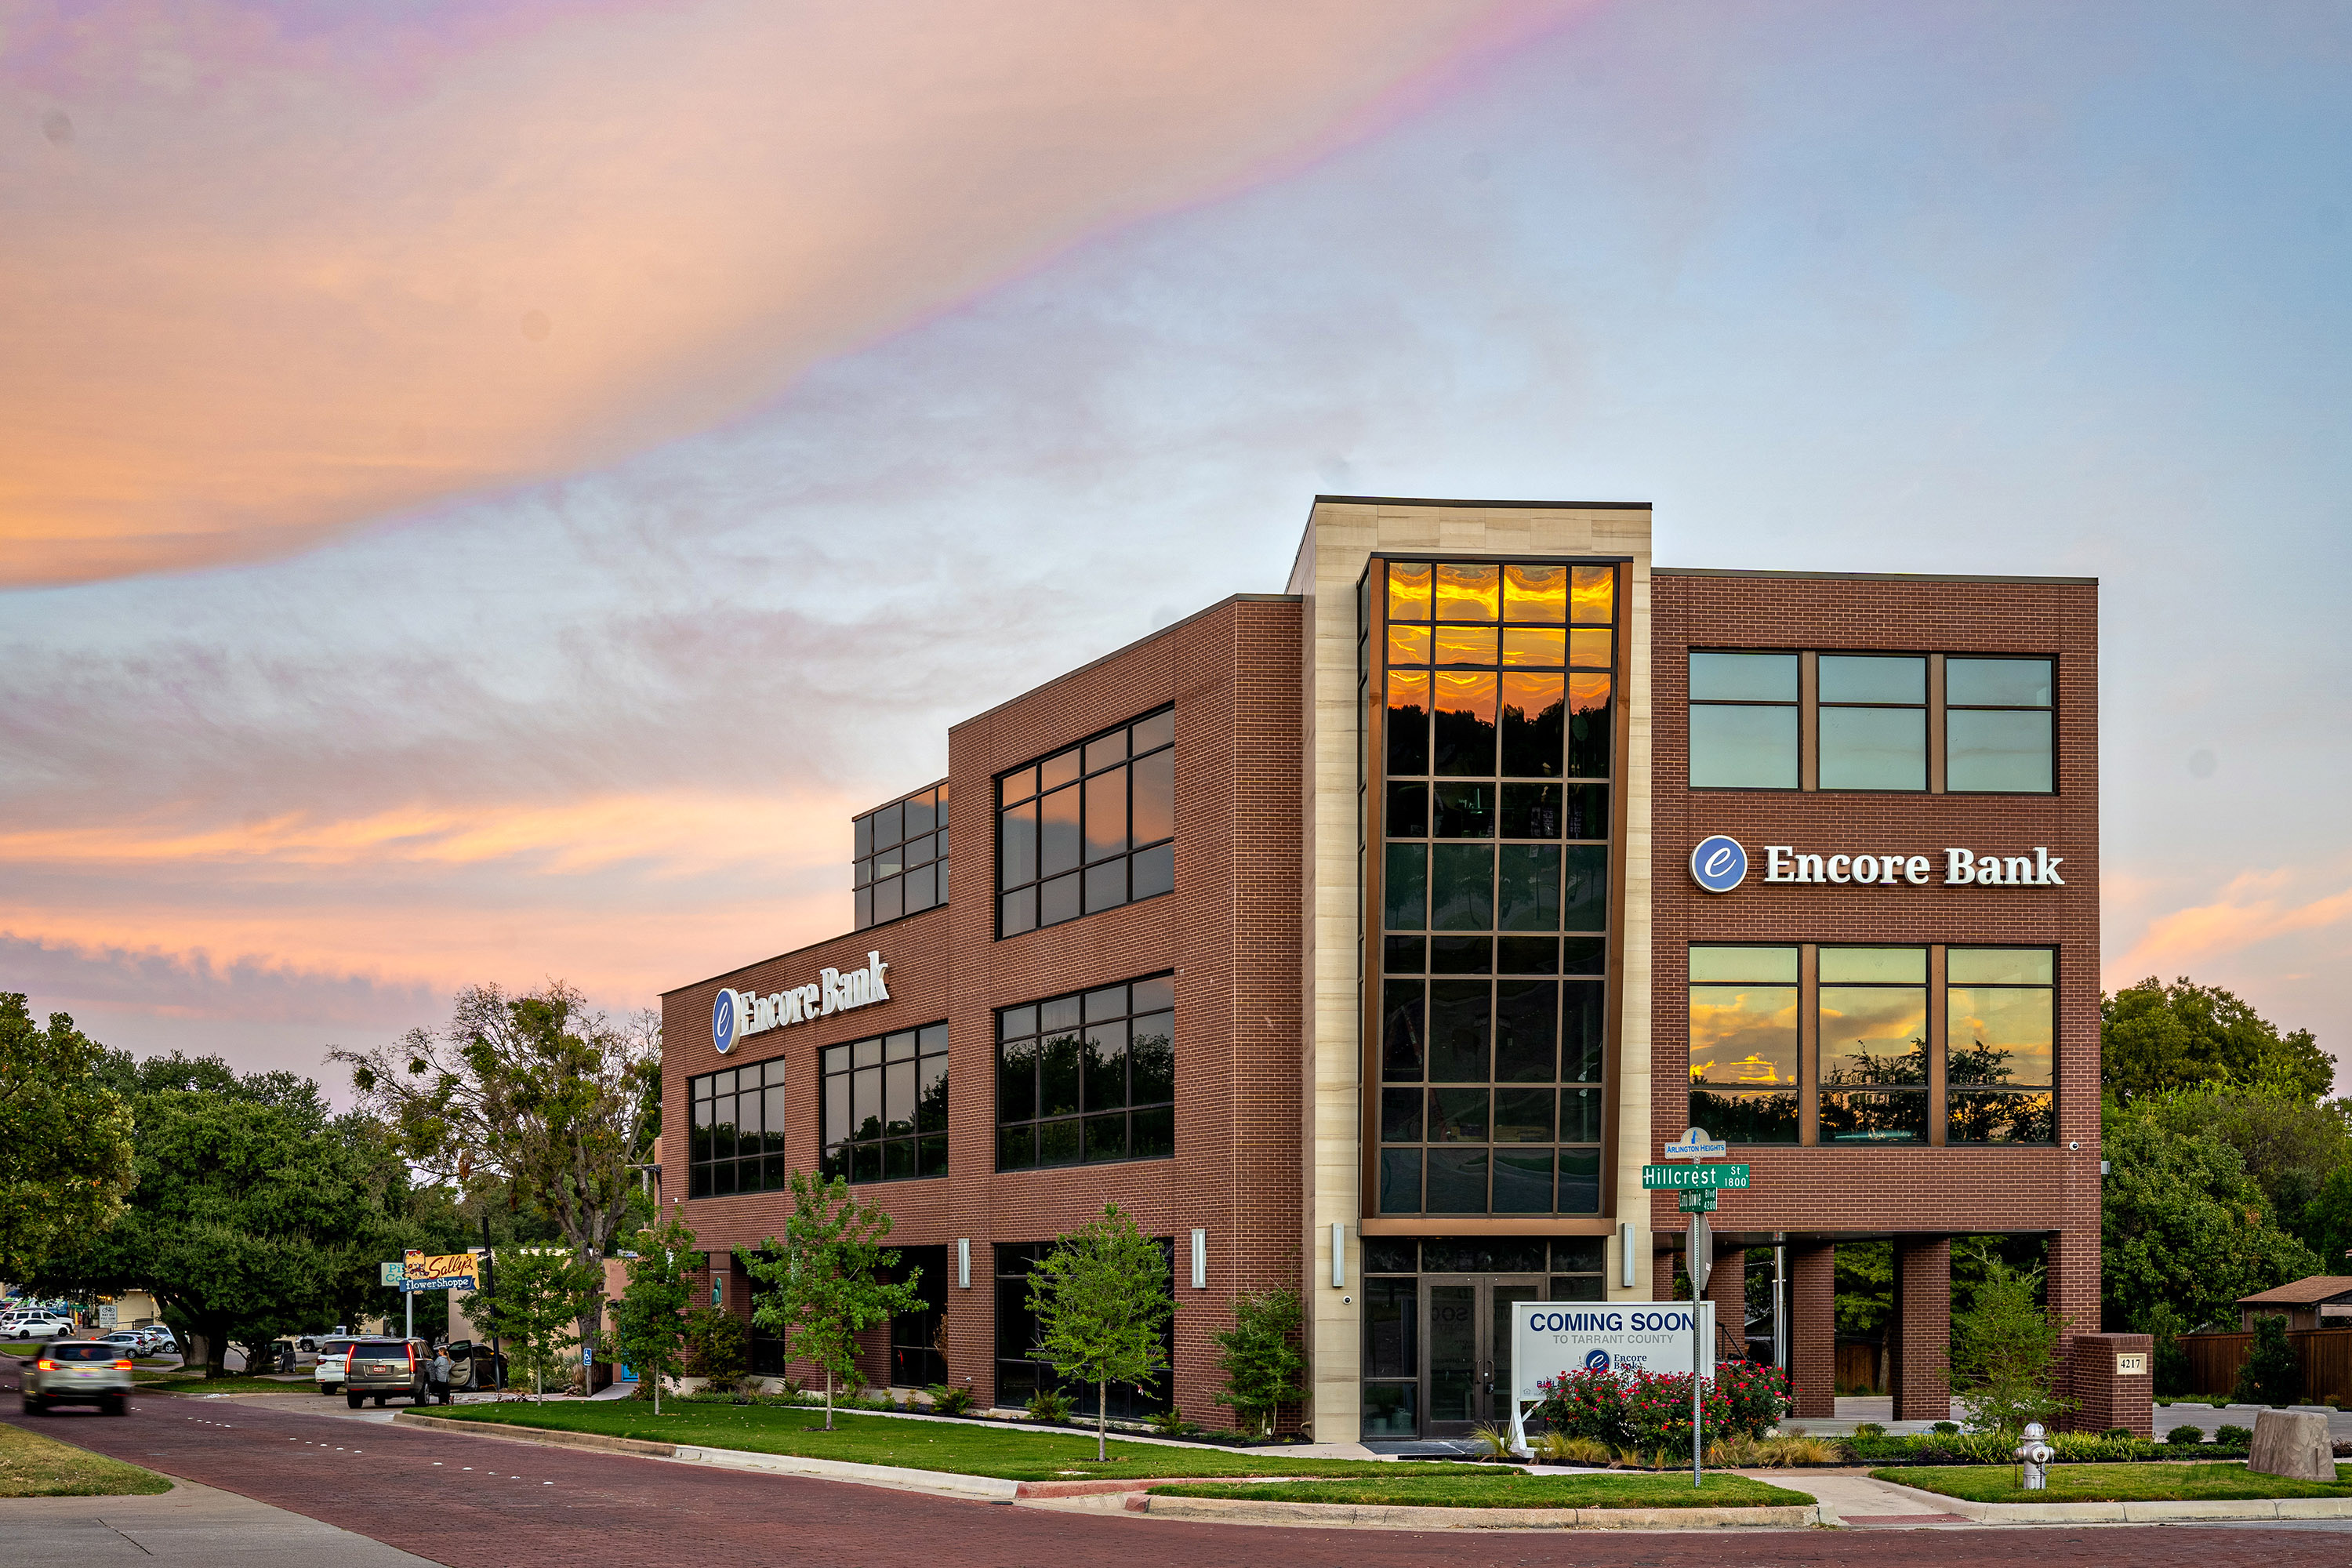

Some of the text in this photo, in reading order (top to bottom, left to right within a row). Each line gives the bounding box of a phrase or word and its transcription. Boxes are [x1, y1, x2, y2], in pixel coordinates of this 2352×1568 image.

[1763, 845, 1931, 884] Encore
[1944, 847, 2066, 886] Bank
[739, 983, 819, 1037] Encore
[820, 950, 890, 1015] Bank
[1646, 1167, 1715, 1185] Hillcrest
[1730, 1166, 1740, 1175] St
[1724, 1178, 1746, 1187] 1800
[1689, 1190, 1701, 1207] Bowie
[1705, 1189, 1715, 1198] Blvd
[1704, 1200, 1716, 1210] 4200
[429, 1255, 474, 1279] Sally's
[1530, 1312, 1694, 1331] COMING SOON
[1553, 1334, 1674, 1344] TO TARRANT COUNTY
[2121, 1359, 2140, 1368] 4217
